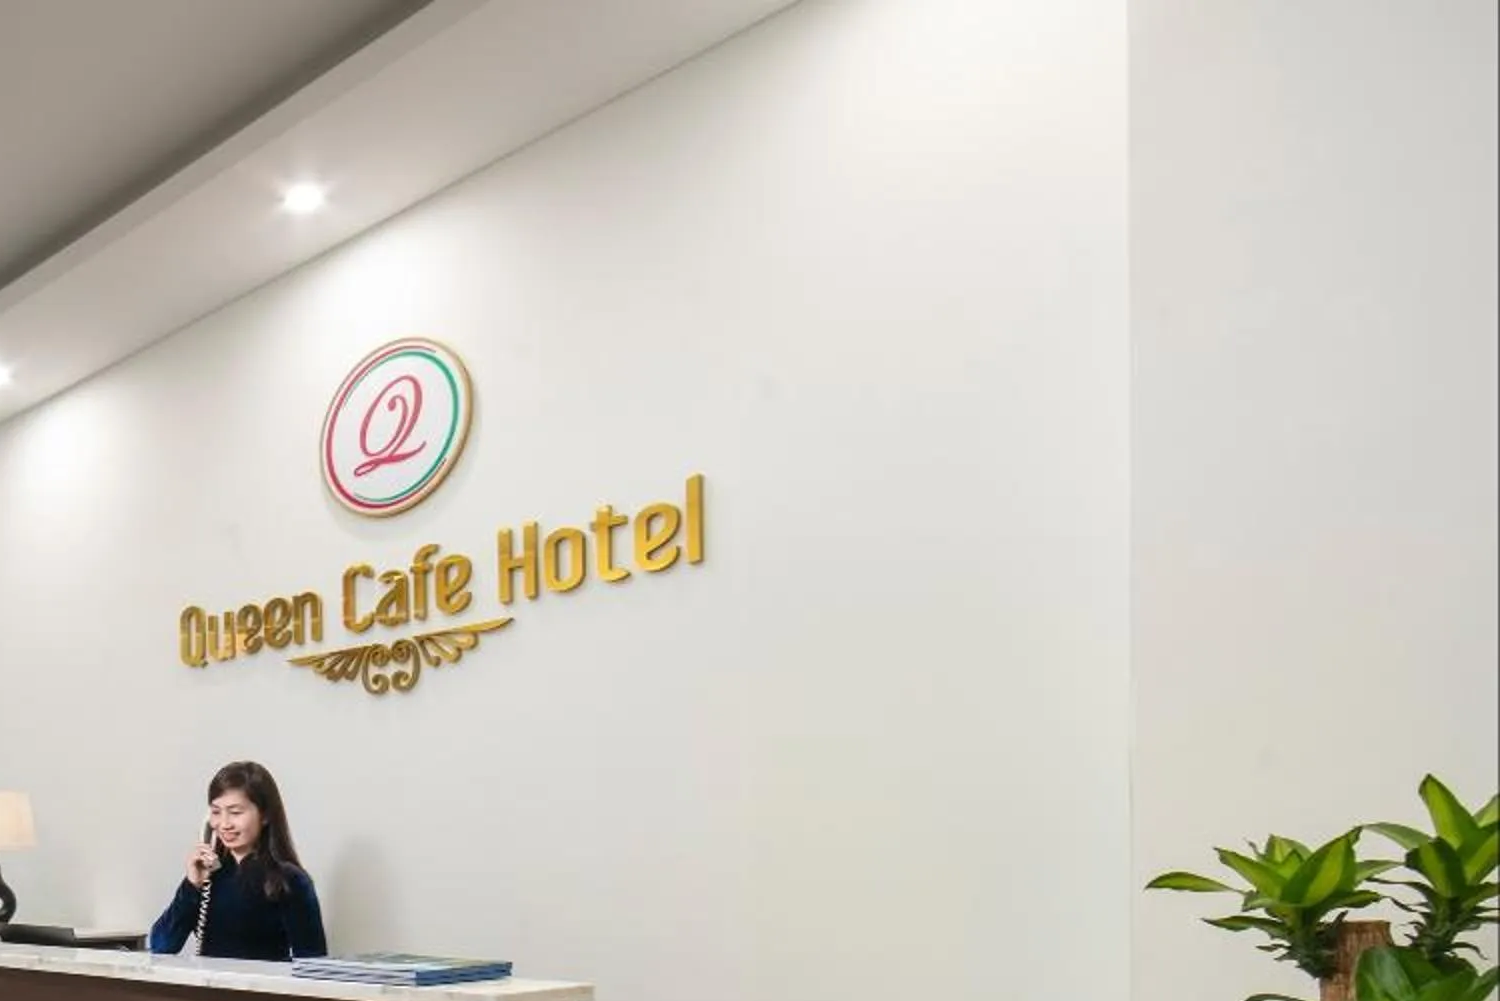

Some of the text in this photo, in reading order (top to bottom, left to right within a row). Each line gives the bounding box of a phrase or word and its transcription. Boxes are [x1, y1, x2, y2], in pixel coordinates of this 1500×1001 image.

[179, 473, 705, 668] Queen Cafe Hotel
